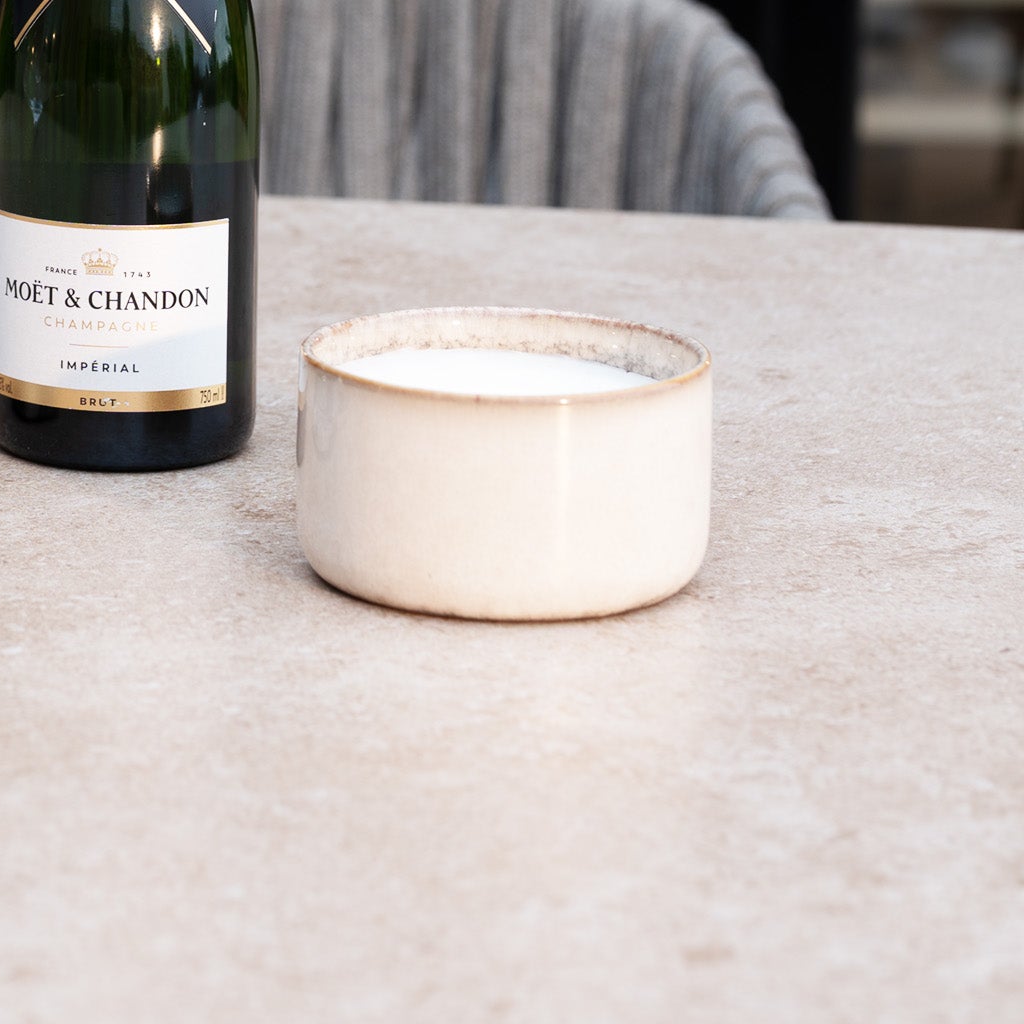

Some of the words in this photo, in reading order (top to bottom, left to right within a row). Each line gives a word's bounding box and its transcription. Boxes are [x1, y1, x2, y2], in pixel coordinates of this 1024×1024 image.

[45, 266, 77, 276] FRANCE
[5, 277, 58, 306] MOËT
[64, 288, 81, 309] &
[88, 286, 209, 311] CHANDON
[44, 316, 159, 332] CHAMPAGNE
[60, 359, 140, 373] IMPÉRIAL
[79, 397, 117, 407] BRUT
